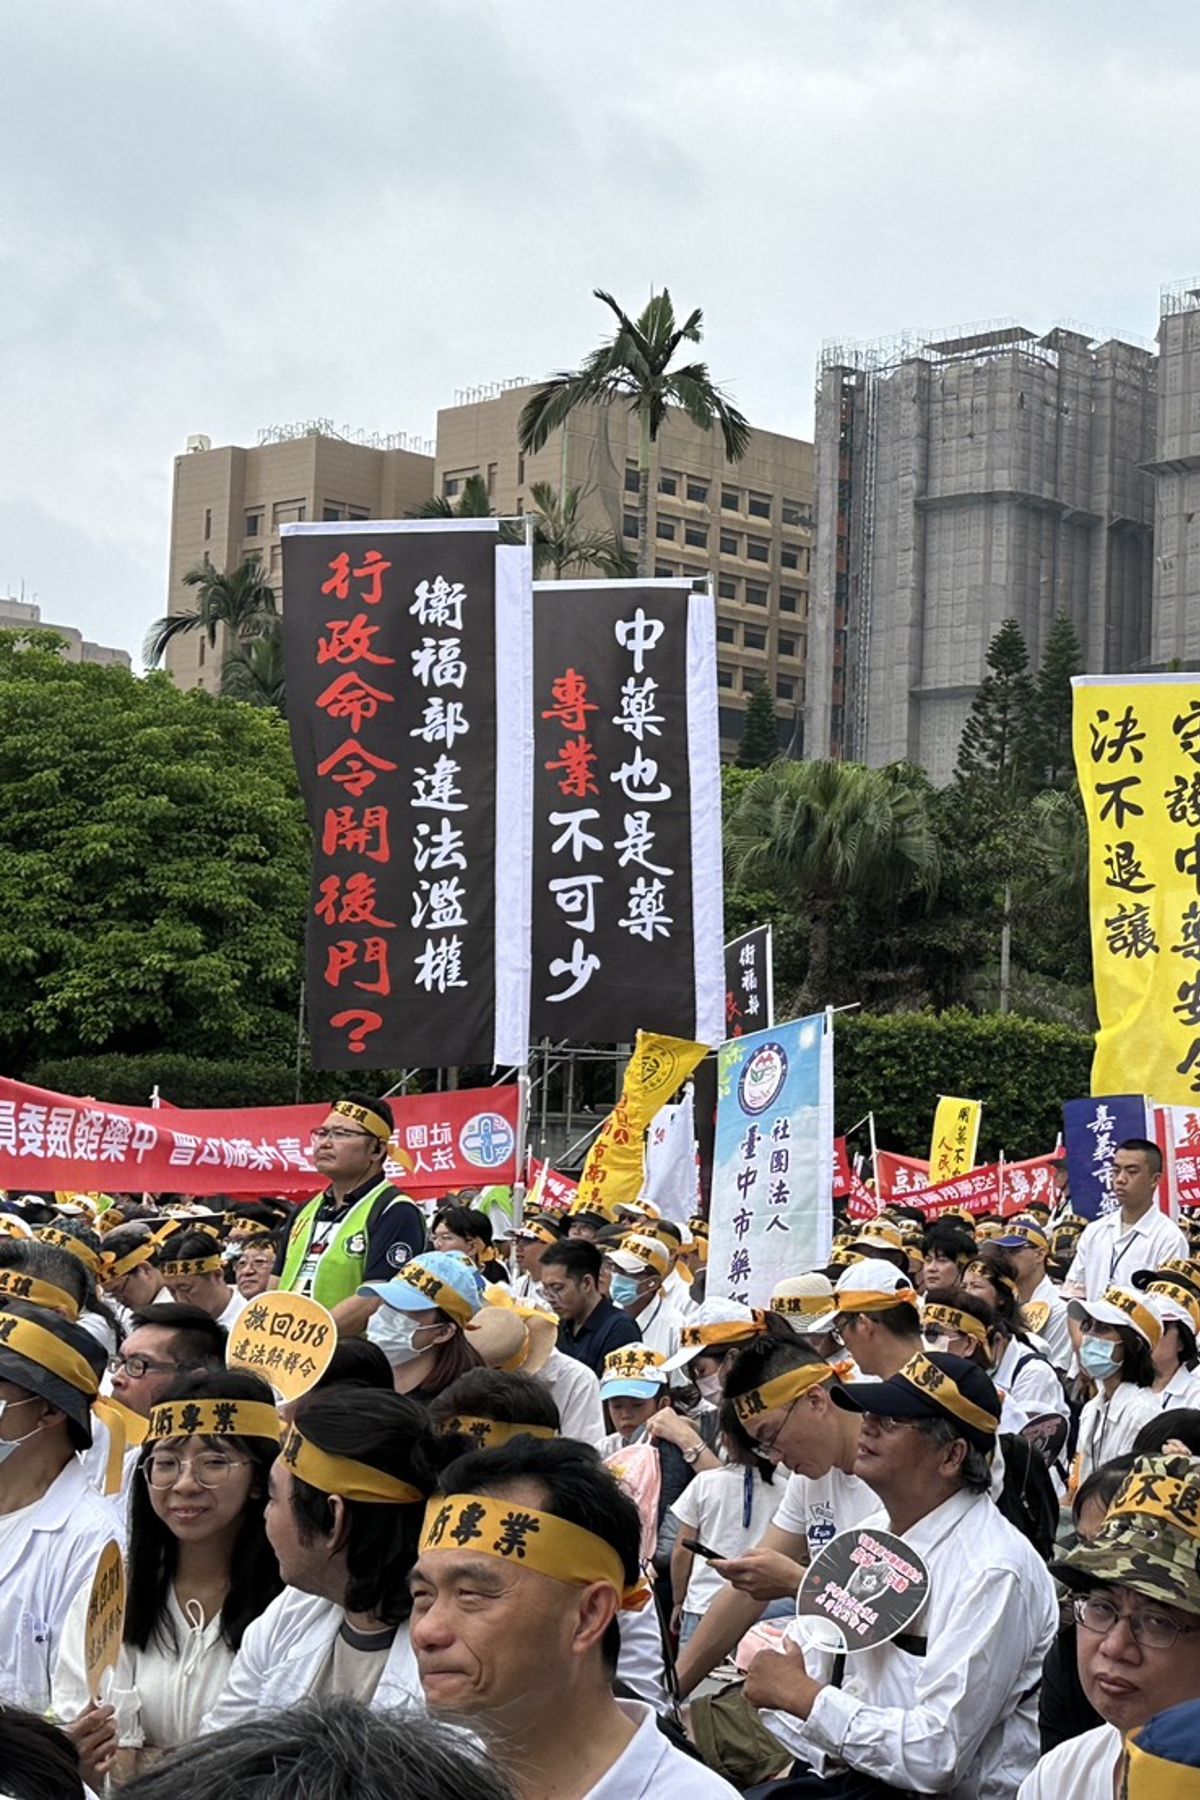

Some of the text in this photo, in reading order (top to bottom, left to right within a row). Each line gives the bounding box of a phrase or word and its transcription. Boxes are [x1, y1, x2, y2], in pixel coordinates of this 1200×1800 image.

[408, 574, 470, 994] 衛福部違法濫權
[541, 667, 604, 1004] 專業不可少
[610, 607, 674, 943] 中藥也是藥
[1089, 708, 1160, 960] 決不退讓
[766, 1119, 791, 1233] 社團法人
[232, 1337, 317, 1379] 違法解釋令
[243, 1302, 329, 1348] 撤回318
